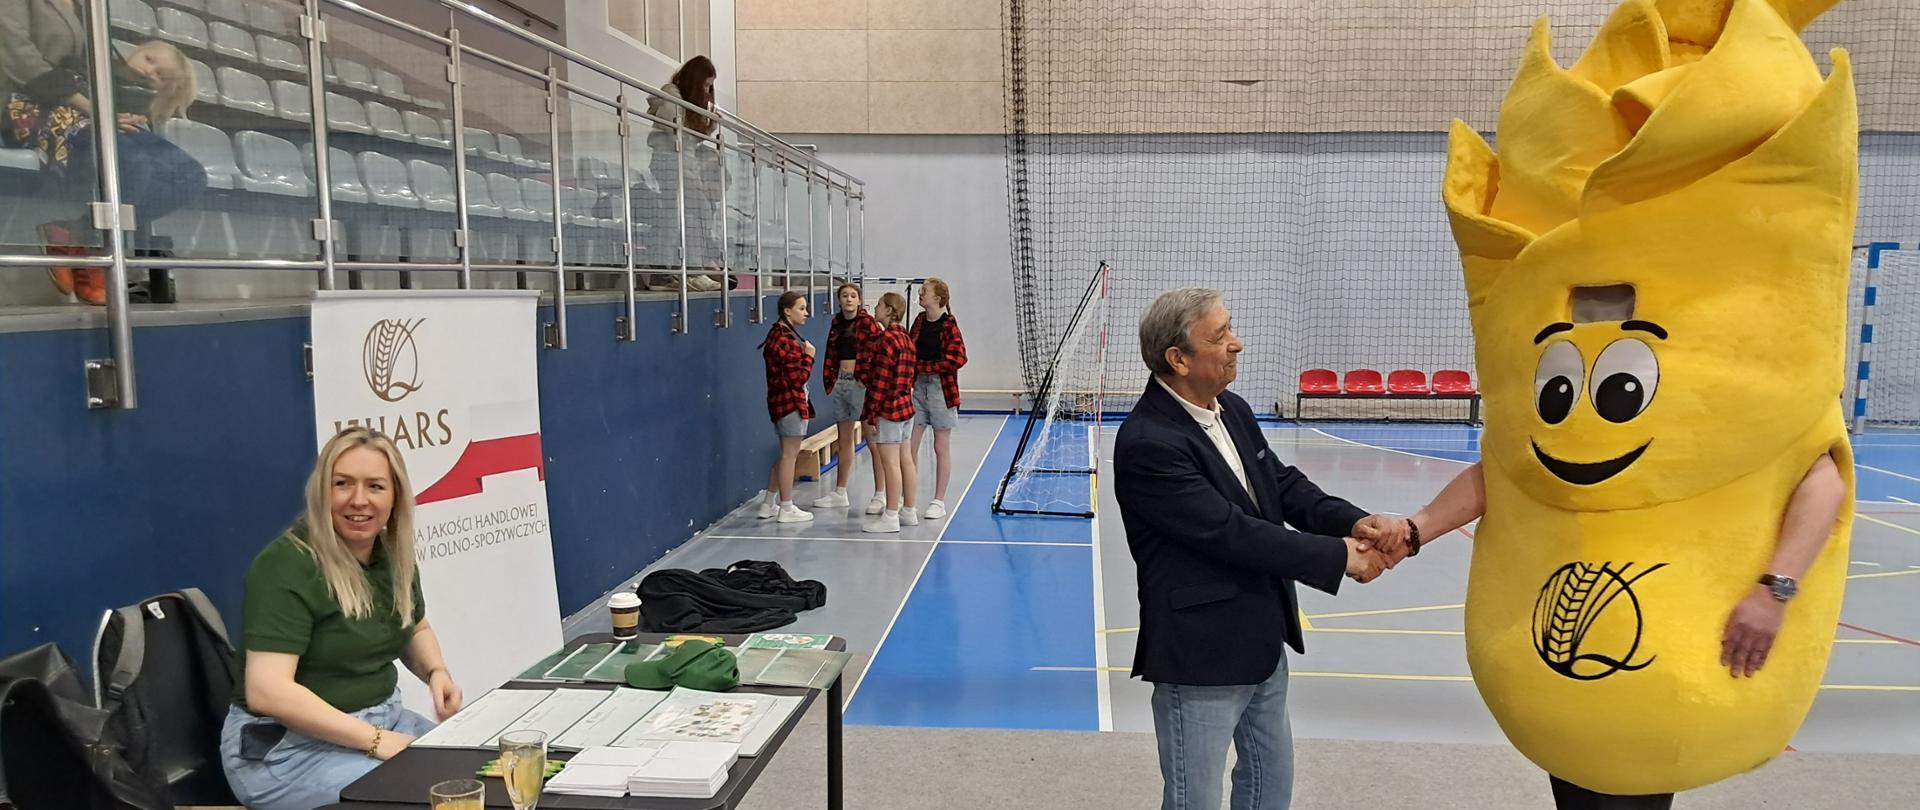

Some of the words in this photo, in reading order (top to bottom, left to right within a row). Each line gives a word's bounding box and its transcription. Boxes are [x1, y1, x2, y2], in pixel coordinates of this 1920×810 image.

[426, 517, 473, 542] JAKOŚCI
[475, 503, 538, 529] HANDLOWEJ
[430, 519, 548, 560] ROLNO-SPOŻYWCZYCH
